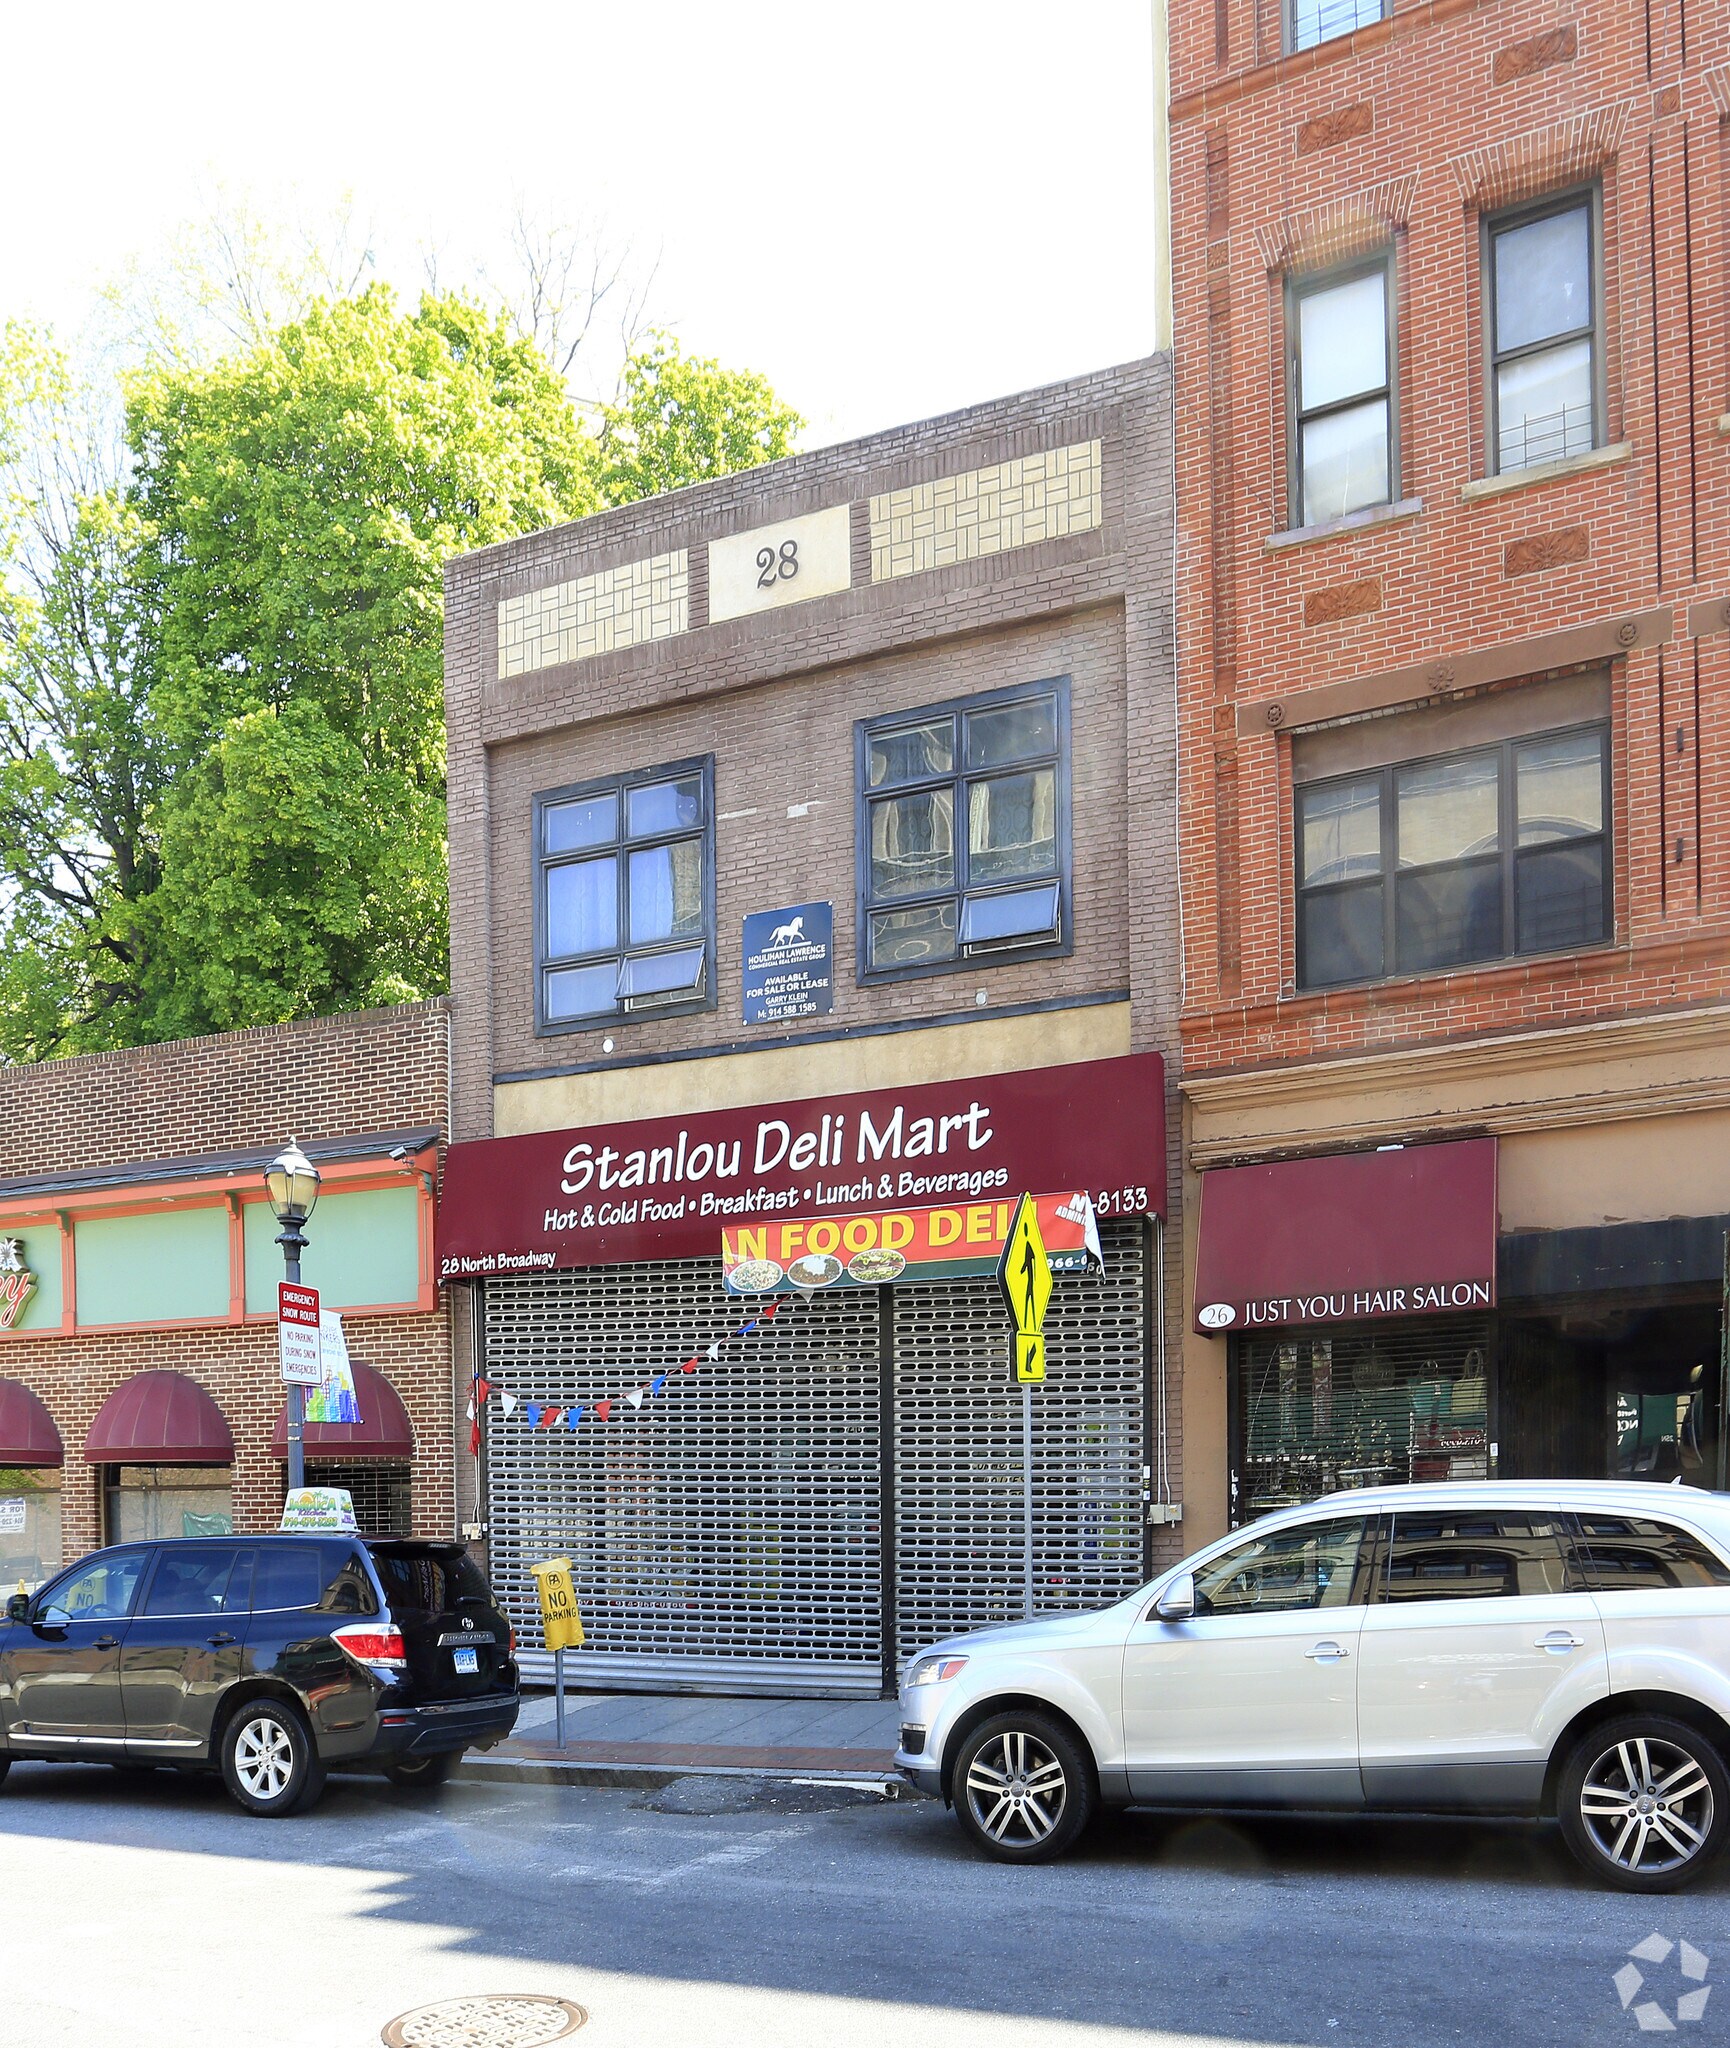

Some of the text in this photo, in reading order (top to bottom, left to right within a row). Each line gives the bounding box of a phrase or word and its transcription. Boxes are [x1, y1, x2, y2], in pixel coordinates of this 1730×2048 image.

[757, 540, 798, 589] 28
[749, 944, 825, 964] HOULIHAN LAWRENCE
[749, 961, 778, 970] COMMERCIAL
[765, 972, 808, 986] AVAILABLE
[746, 979, 828, 998] FOR SALE OR LEASE
[766, 994, 788, 1005] GARRY
[789, 992, 808, 1001] KLEIN
[758, 1010, 766, 1018] M:
[769, 1007, 781, 1017] 914
[784, 1004, 796, 1014] 588
[800, 1002, 816, 1012] 1585
[561, 1102, 993, 1194] Stanlou Deli Mart
[544, 1167, 1008, 1232] Hot & Cold Food Breakfast Lunch & Beverages
[780, 1213, 914, 1260] FOOD
[929, 1202, 1037, 1246] DEL
[442, 1250, 556, 1275] 28 North Broadway
[283, 1291, 315, 1306] EMERGENCY
[1206, 1282, 1490, 1325] 26 JUST YOU HAIR SALON
[282, 1307, 317, 1322] SNOW ROUTE
[287, 1331, 313, 1344] NO PARKING
[286, 1346, 302, 1358] DURING
[304, 1348, 316, 1359] SNOW
[286, 1362, 317, 1375] EMERGENCIES
[549, 1574, 560, 1585] PA
[77, 1594, 93, 1606] NO
[548, 1590, 567, 1609] NO
[544, 1608, 576, 1623] PARKING
